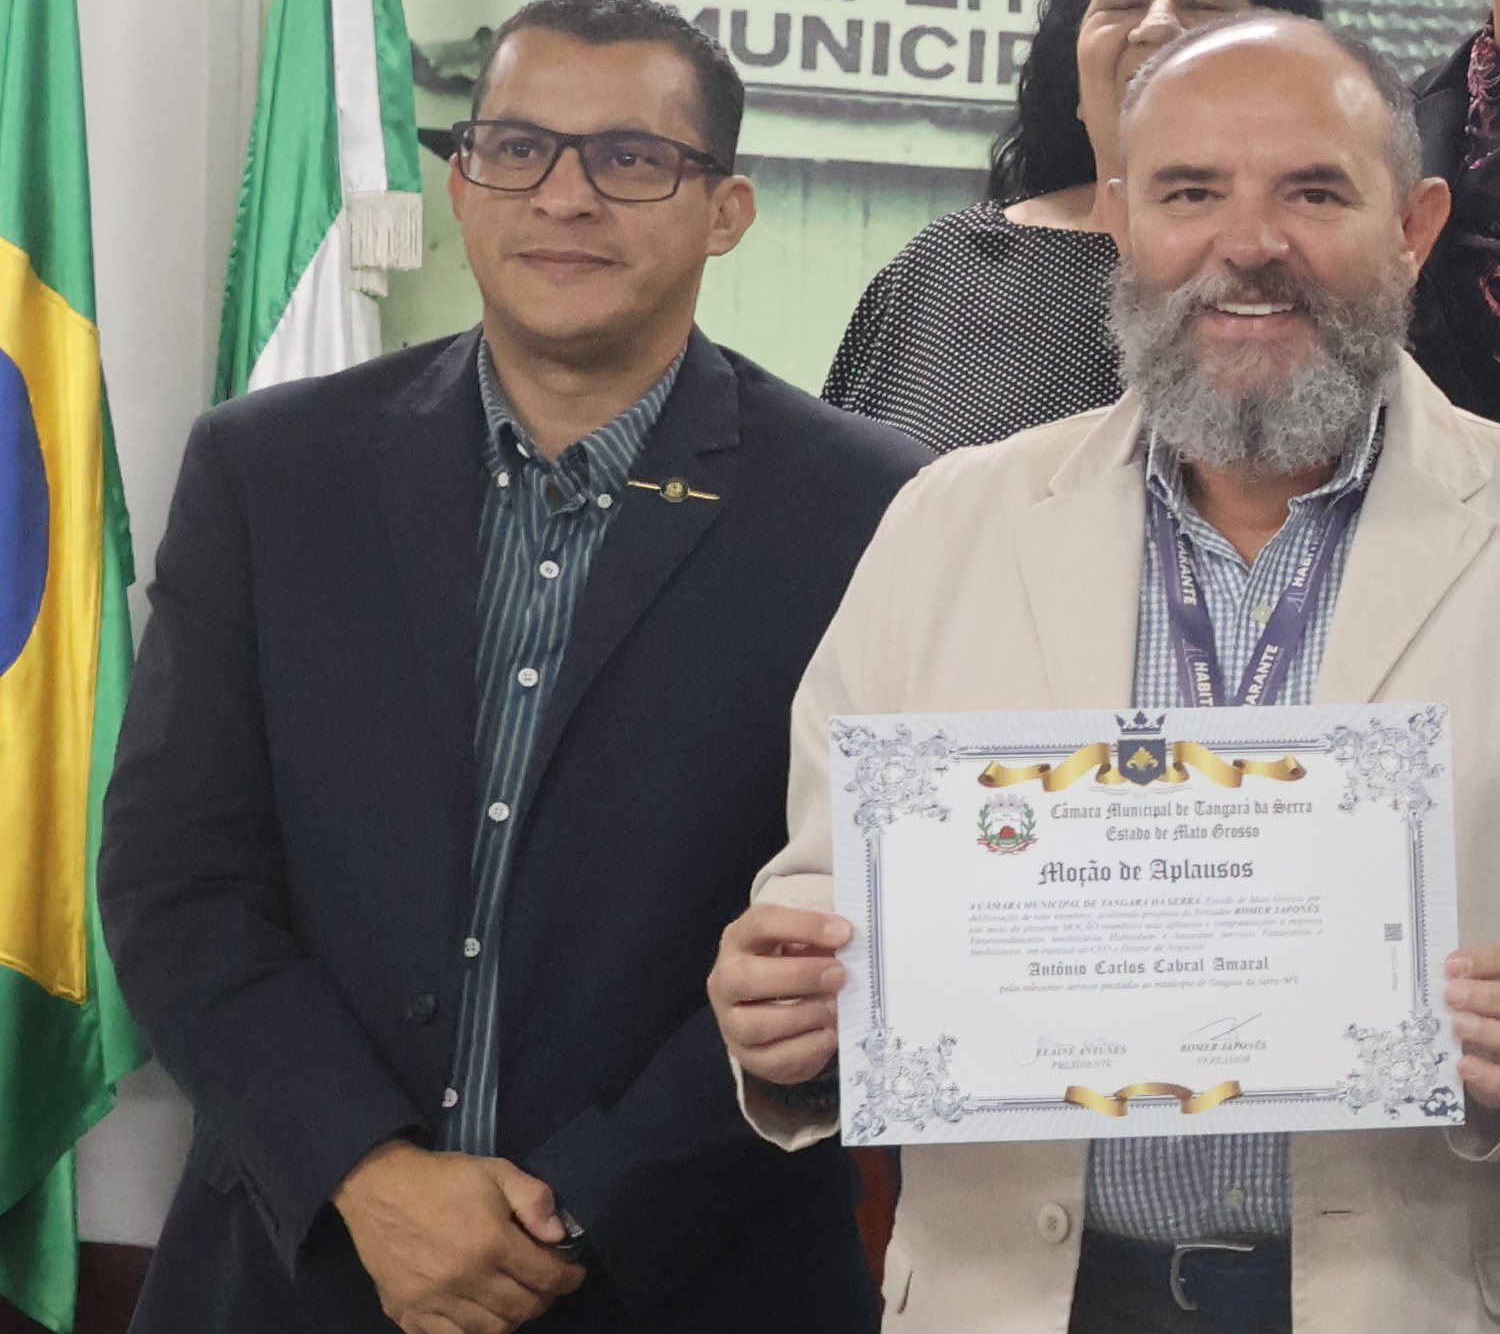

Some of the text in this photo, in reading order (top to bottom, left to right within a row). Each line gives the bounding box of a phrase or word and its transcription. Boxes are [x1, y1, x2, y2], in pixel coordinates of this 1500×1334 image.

[1050, 798, 1312, 819] Câmara Municipal de Tangará da Serra
[1105, 822, 1259, 841] Estado de Mato Grosso
[1037, 857, 1253, 888] Moção de Aplausos
[1094, 959, 1145, 975] Carlos
[1153, 957, 1204, 973] Cabral
[1213, 956, 1269, 971] Amaral
